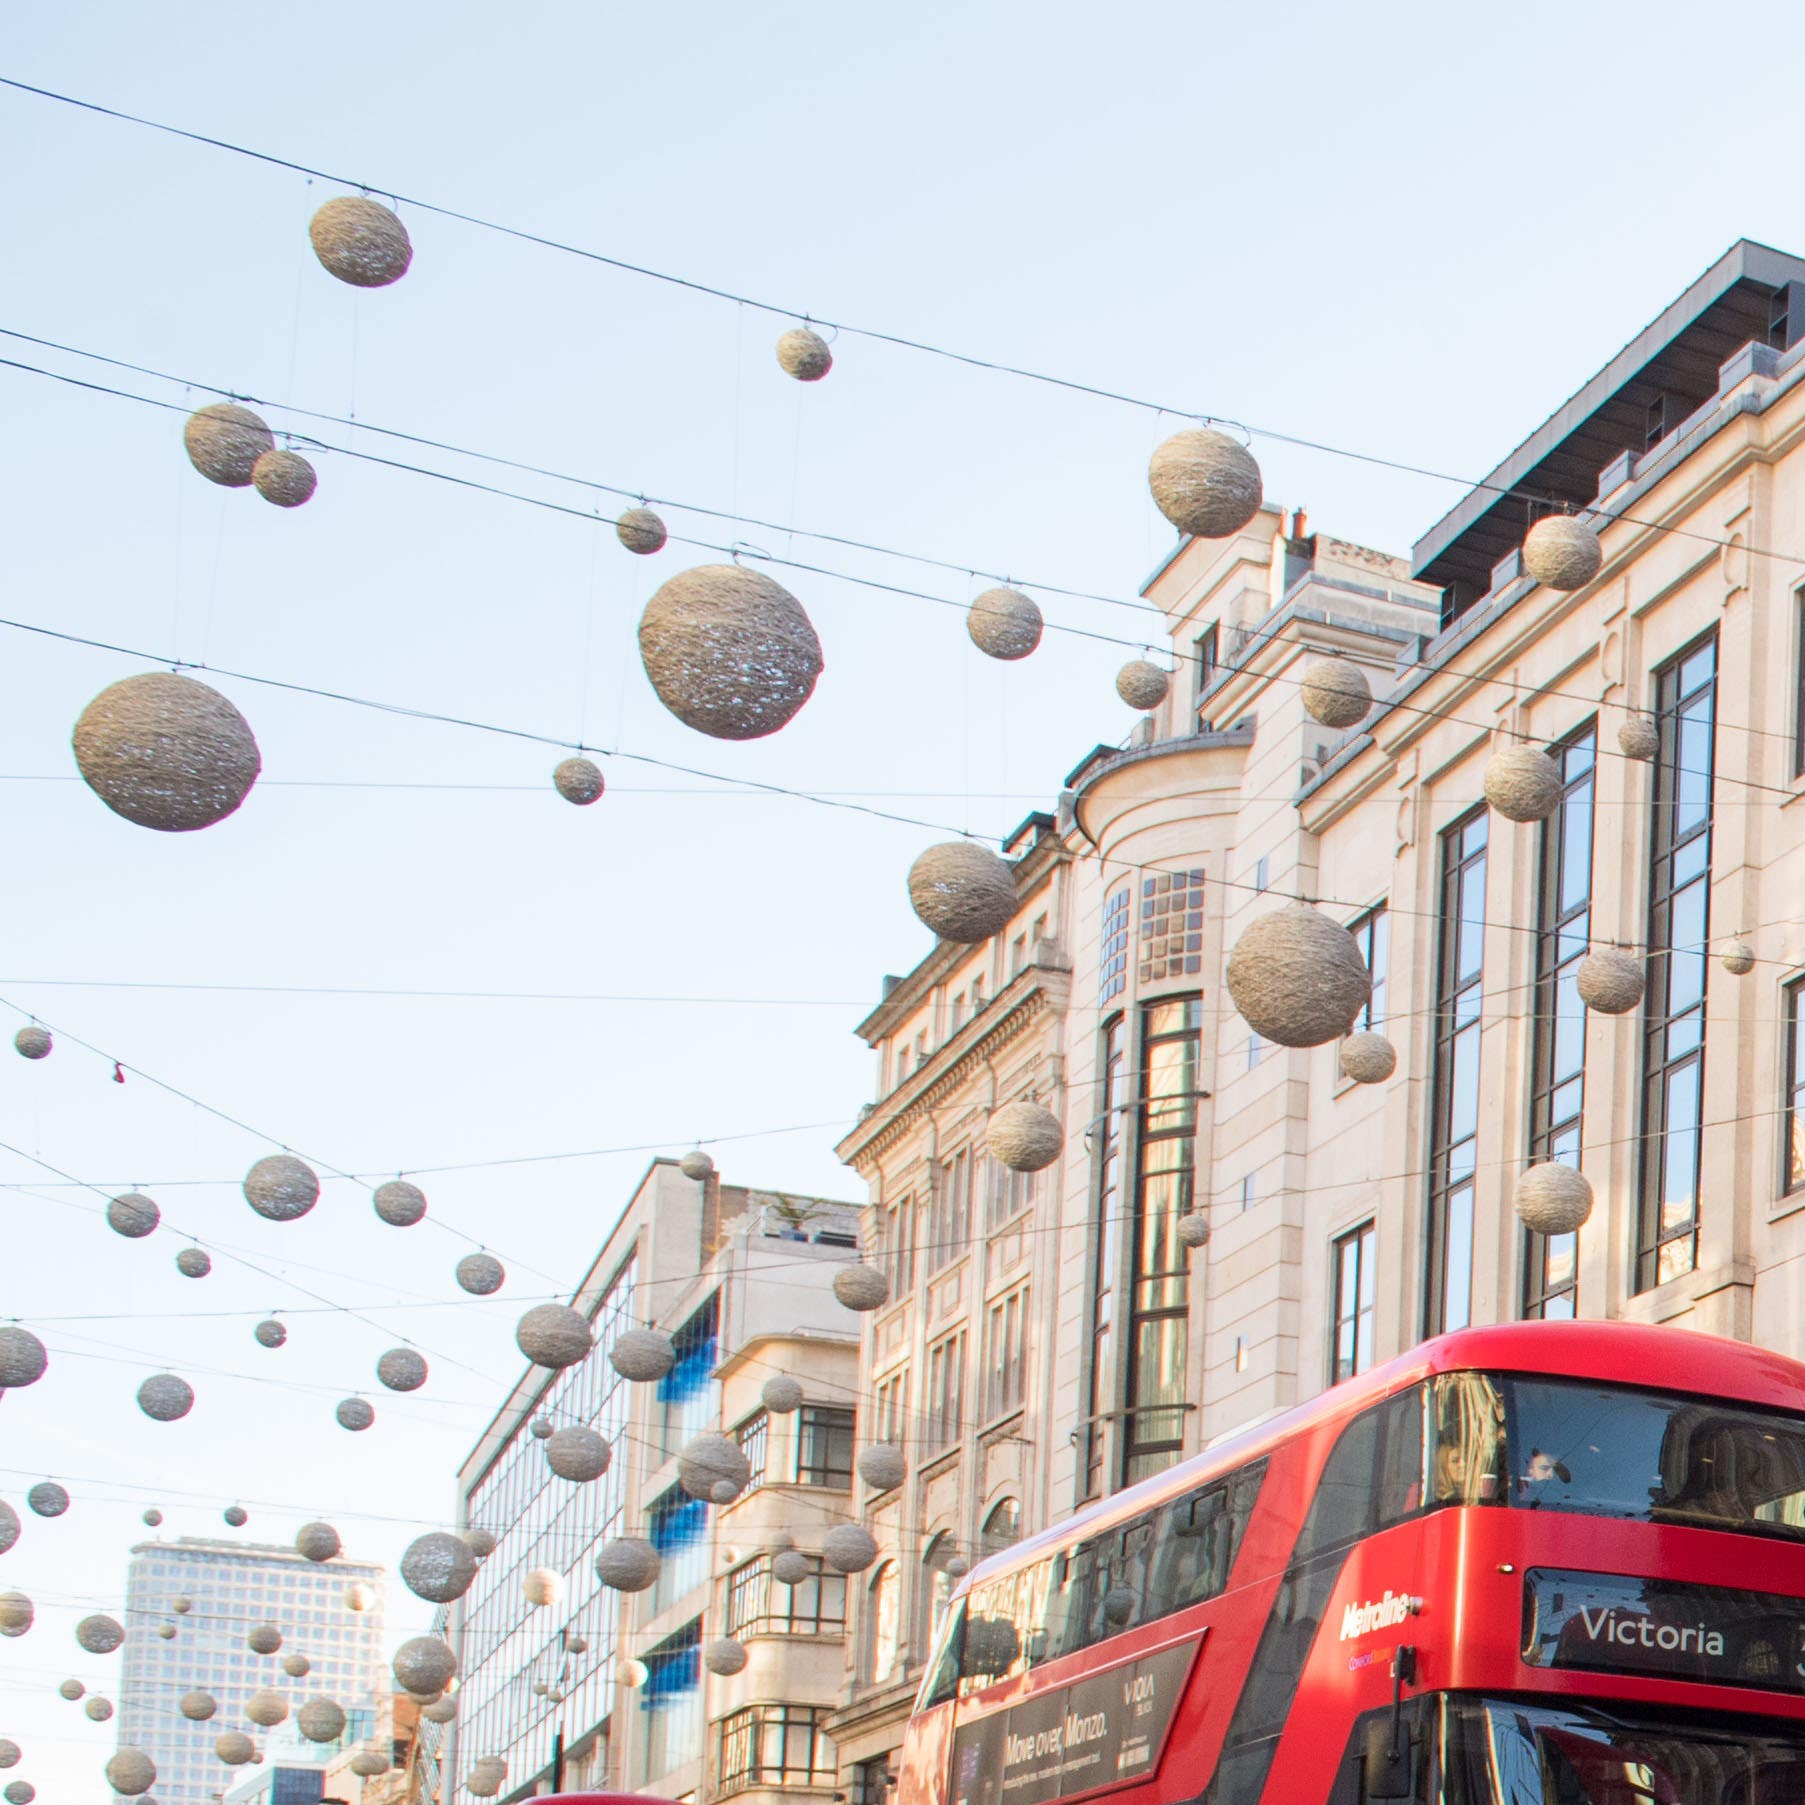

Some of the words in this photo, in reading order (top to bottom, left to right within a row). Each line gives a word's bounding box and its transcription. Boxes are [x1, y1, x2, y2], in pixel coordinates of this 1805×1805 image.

[1340, 1590, 1409, 1641] Metroline
[1579, 1604, 1724, 1656] Victoria
[1004, 1732, 1035, 1768] Move
[1063, 1712, 1108, 1749] Monzo.
